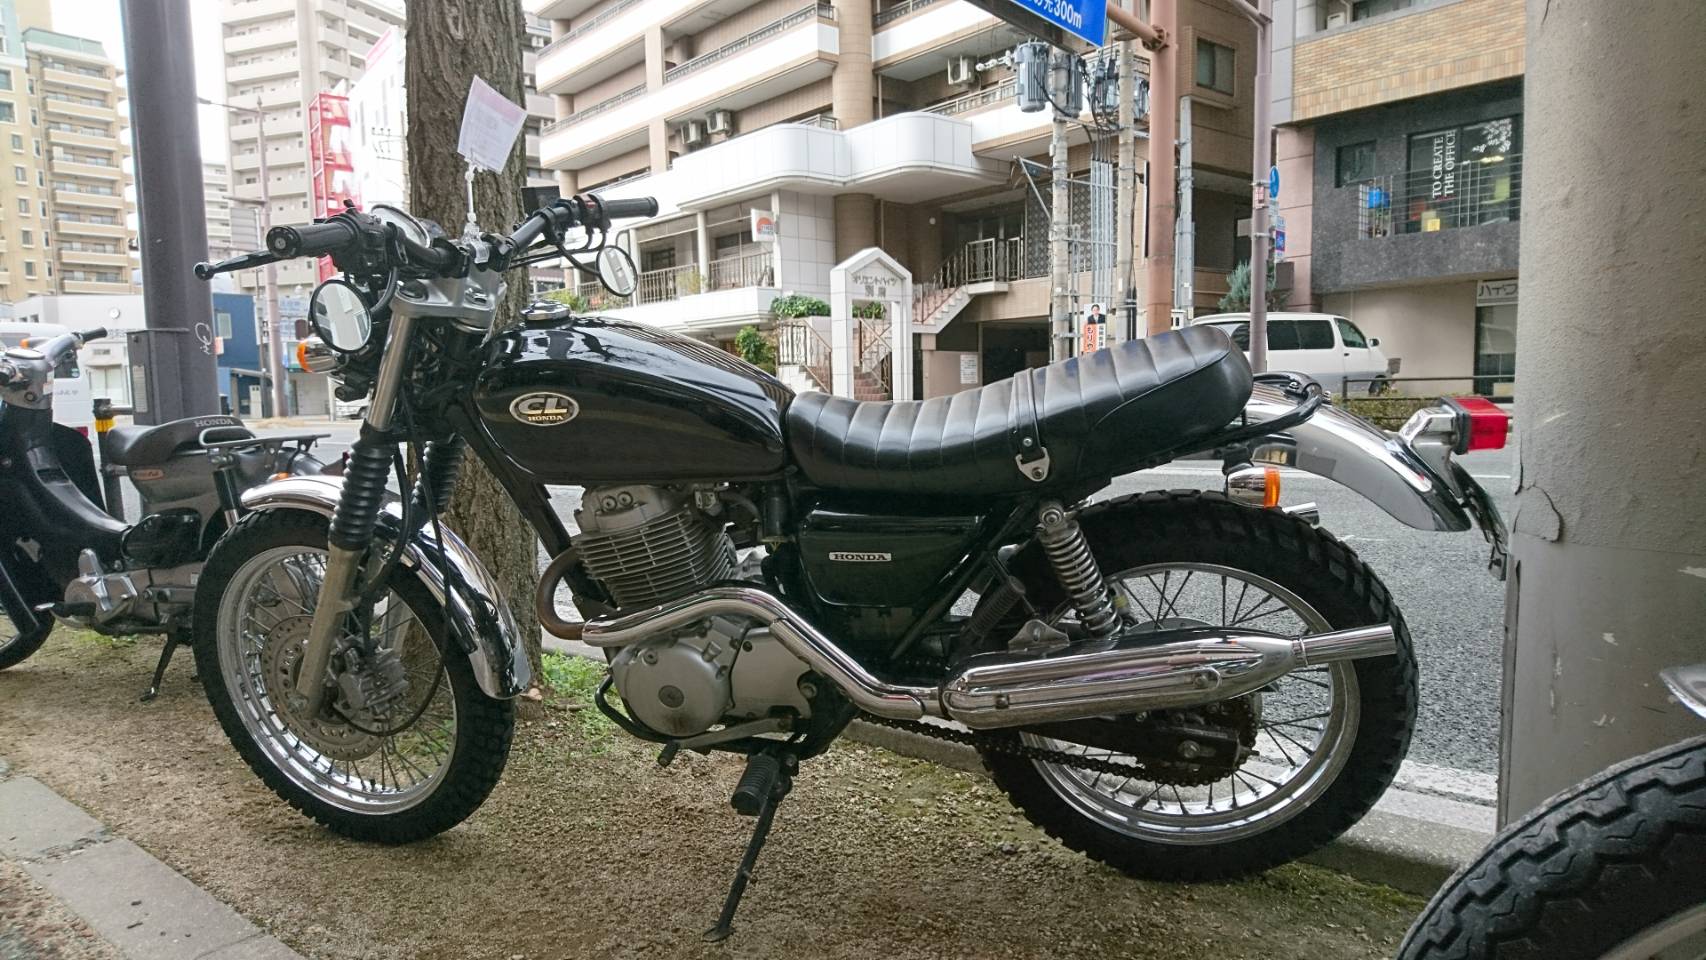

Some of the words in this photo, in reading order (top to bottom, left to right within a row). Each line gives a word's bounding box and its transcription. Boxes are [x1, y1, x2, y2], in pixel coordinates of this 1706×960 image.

[1433, 136, 1443, 179] CREATE
[1433, 181, 1442, 198] TO
[1445, 171, 1454, 197] THE
[518, 398, 567, 414] CL
[194, 418, 234, 427] HONDA
